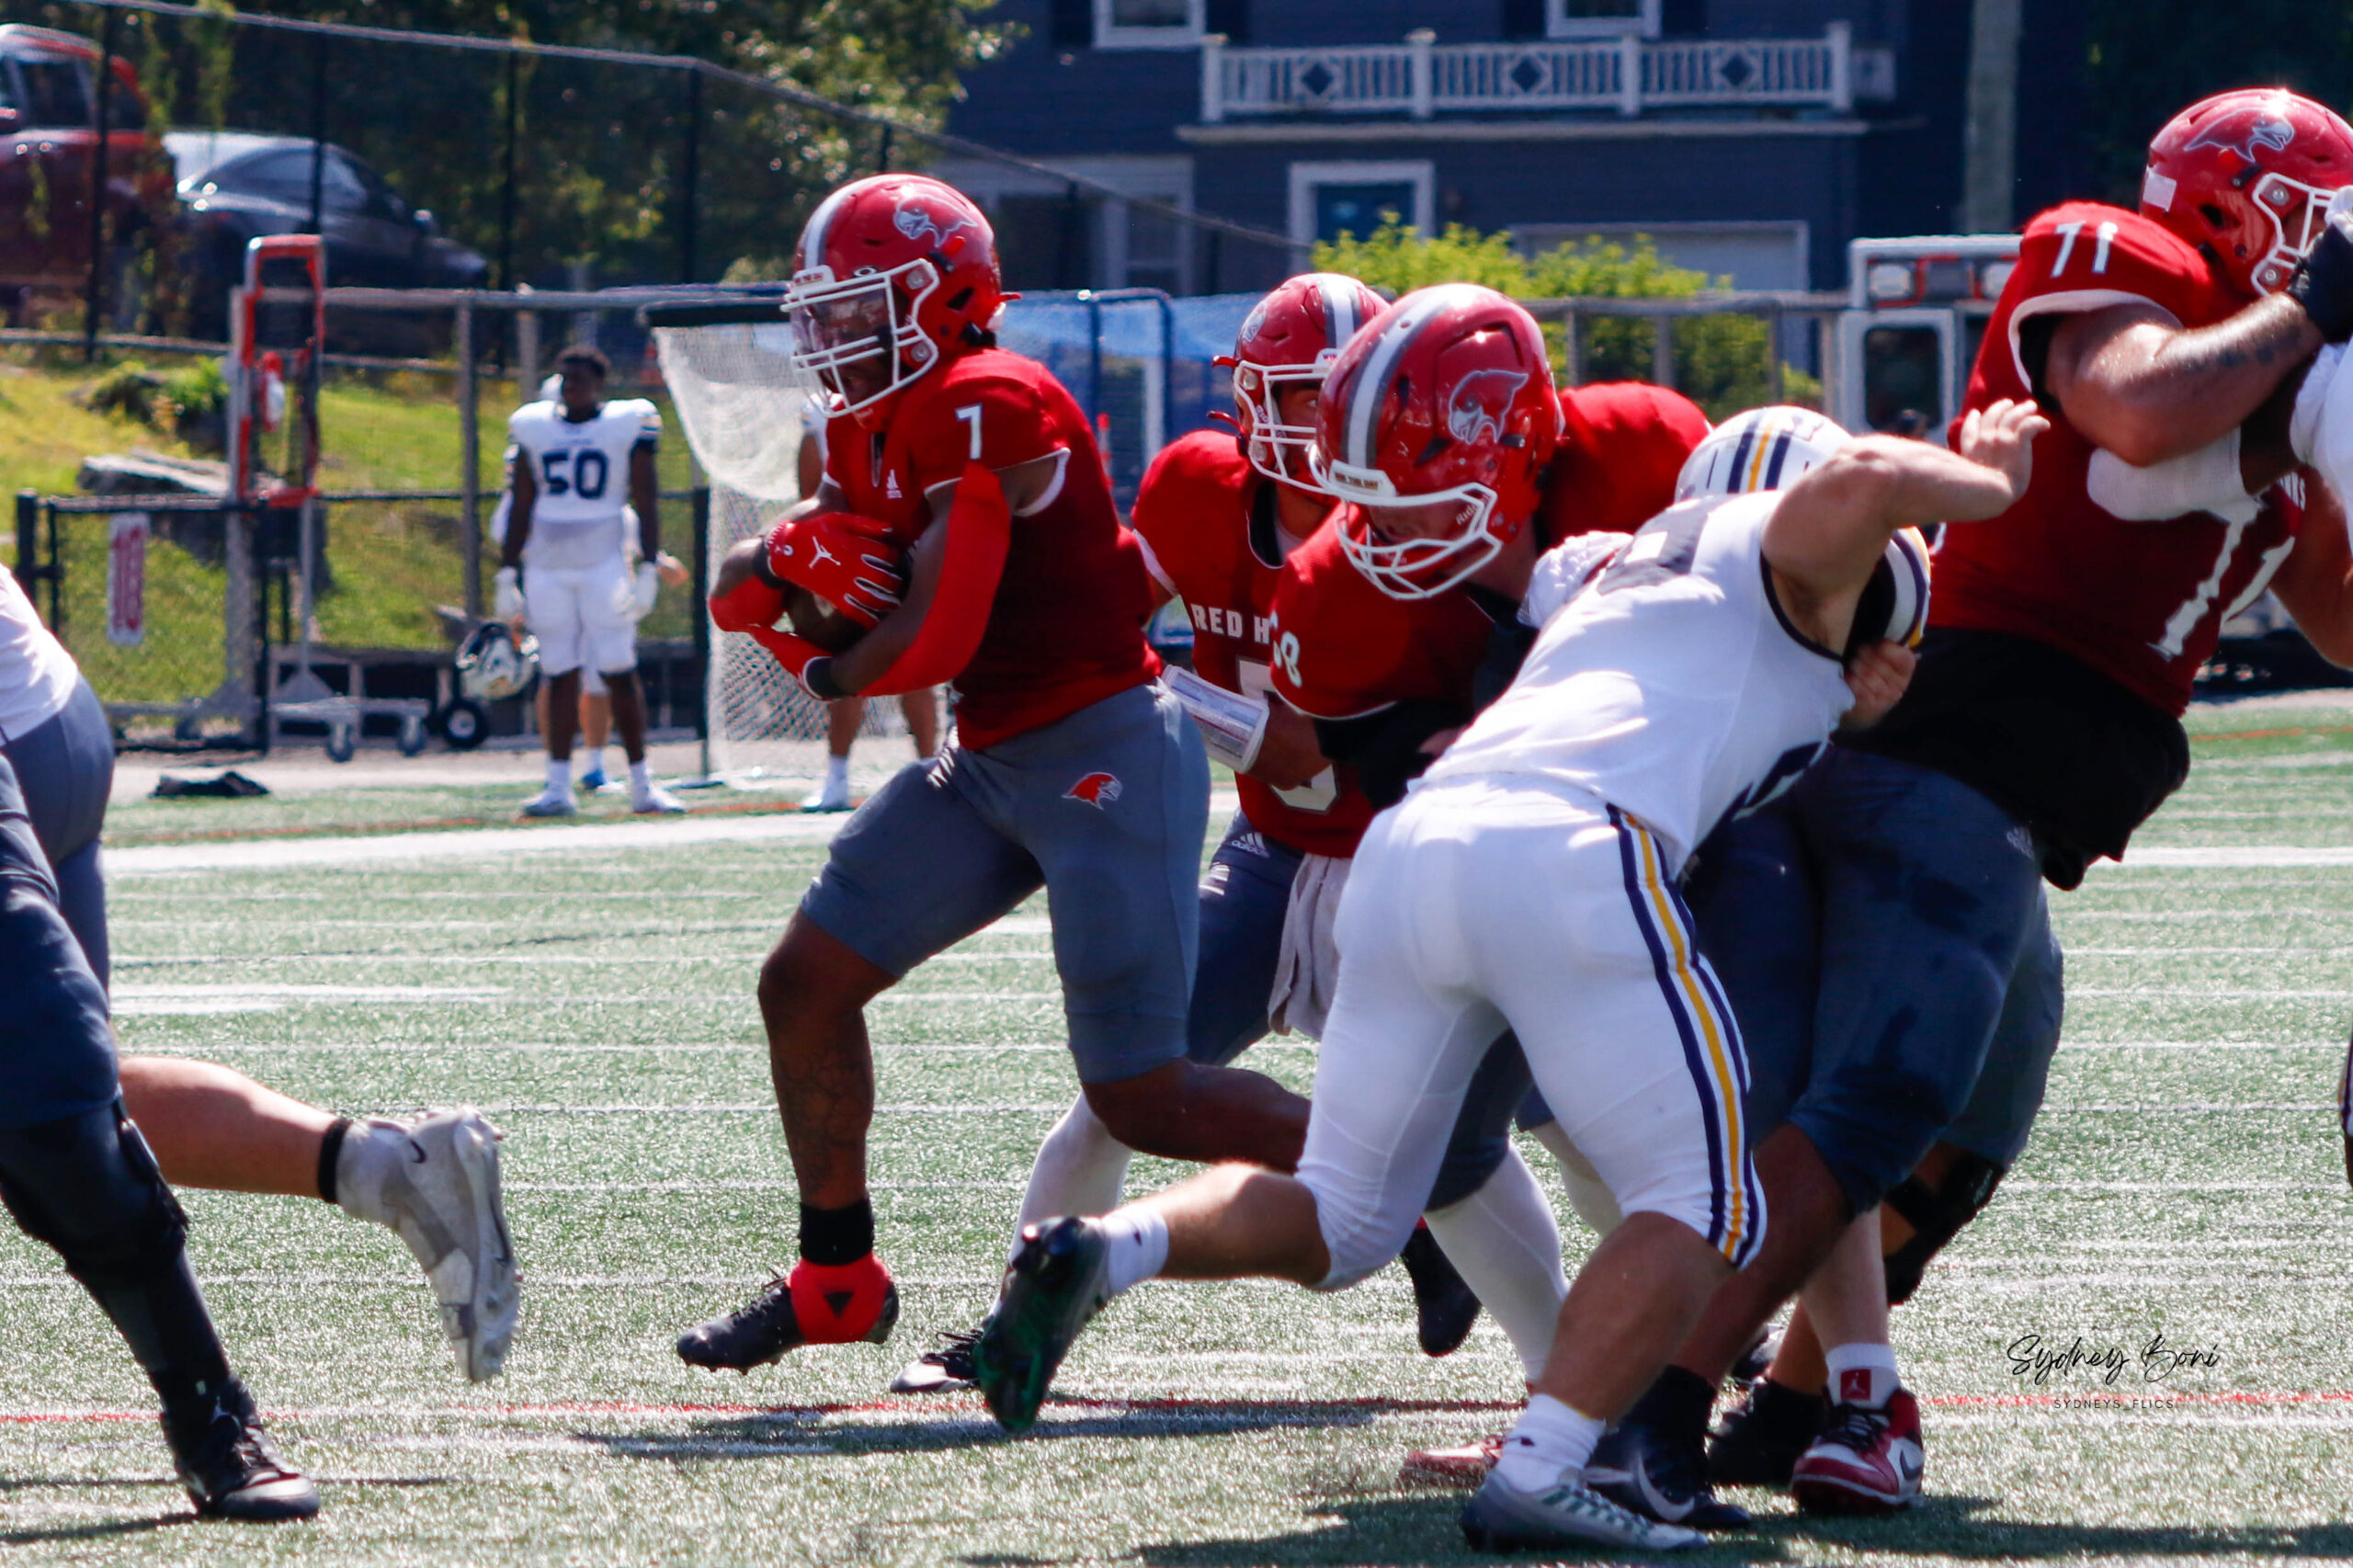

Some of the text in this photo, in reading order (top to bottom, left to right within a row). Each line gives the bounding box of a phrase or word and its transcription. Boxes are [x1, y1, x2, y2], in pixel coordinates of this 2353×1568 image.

[955, 403, 983, 460] 7
[542, 450, 608, 499] 50
[1190, 603, 1243, 638] RED
